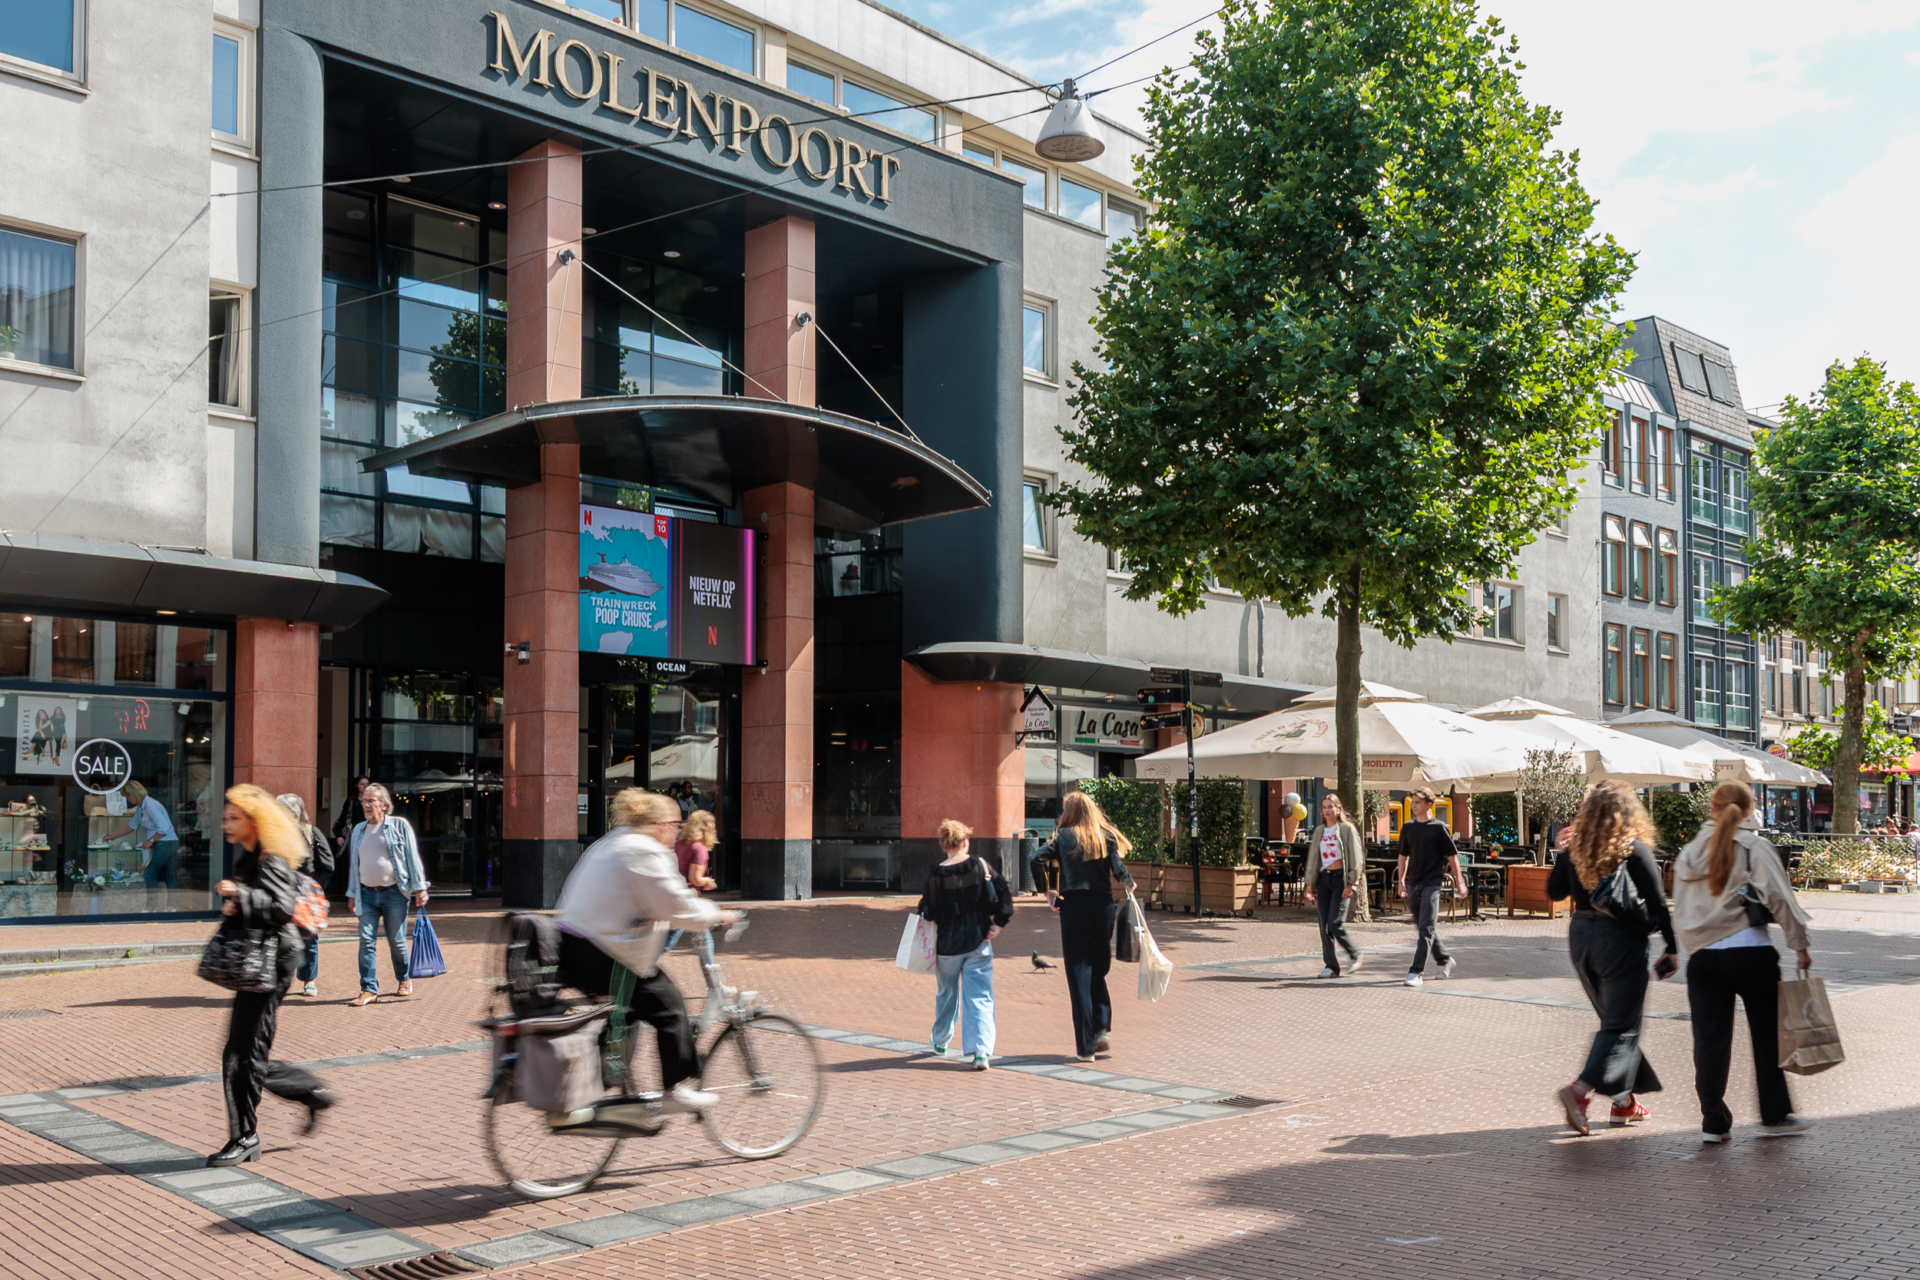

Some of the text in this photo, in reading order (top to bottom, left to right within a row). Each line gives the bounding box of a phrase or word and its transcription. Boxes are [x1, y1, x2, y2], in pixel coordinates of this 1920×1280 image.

[489, 10, 900, 204] MOLENPOORT
[584, 509, 592, 526] N
[657, 525, 667, 533] 10
[689, 575, 736, 594] NIEUW OP
[591, 596, 657, 611] TRAINWRECK
[693, 591, 731, 609] NETFLIX
[595, 607, 653, 629] POOP CRUISE
[708, 625, 717, 646] N
[656, 661, 686, 673] OCEAN
[1025, 717, 1049, 728] La Casa
[1076, 710, 1139, 738] La Casa
[21, 708, 31, 761] HSPANITAS
[78, 755, 125, 775] SALE
[1362, 760, 1403, 768] MORETTI
